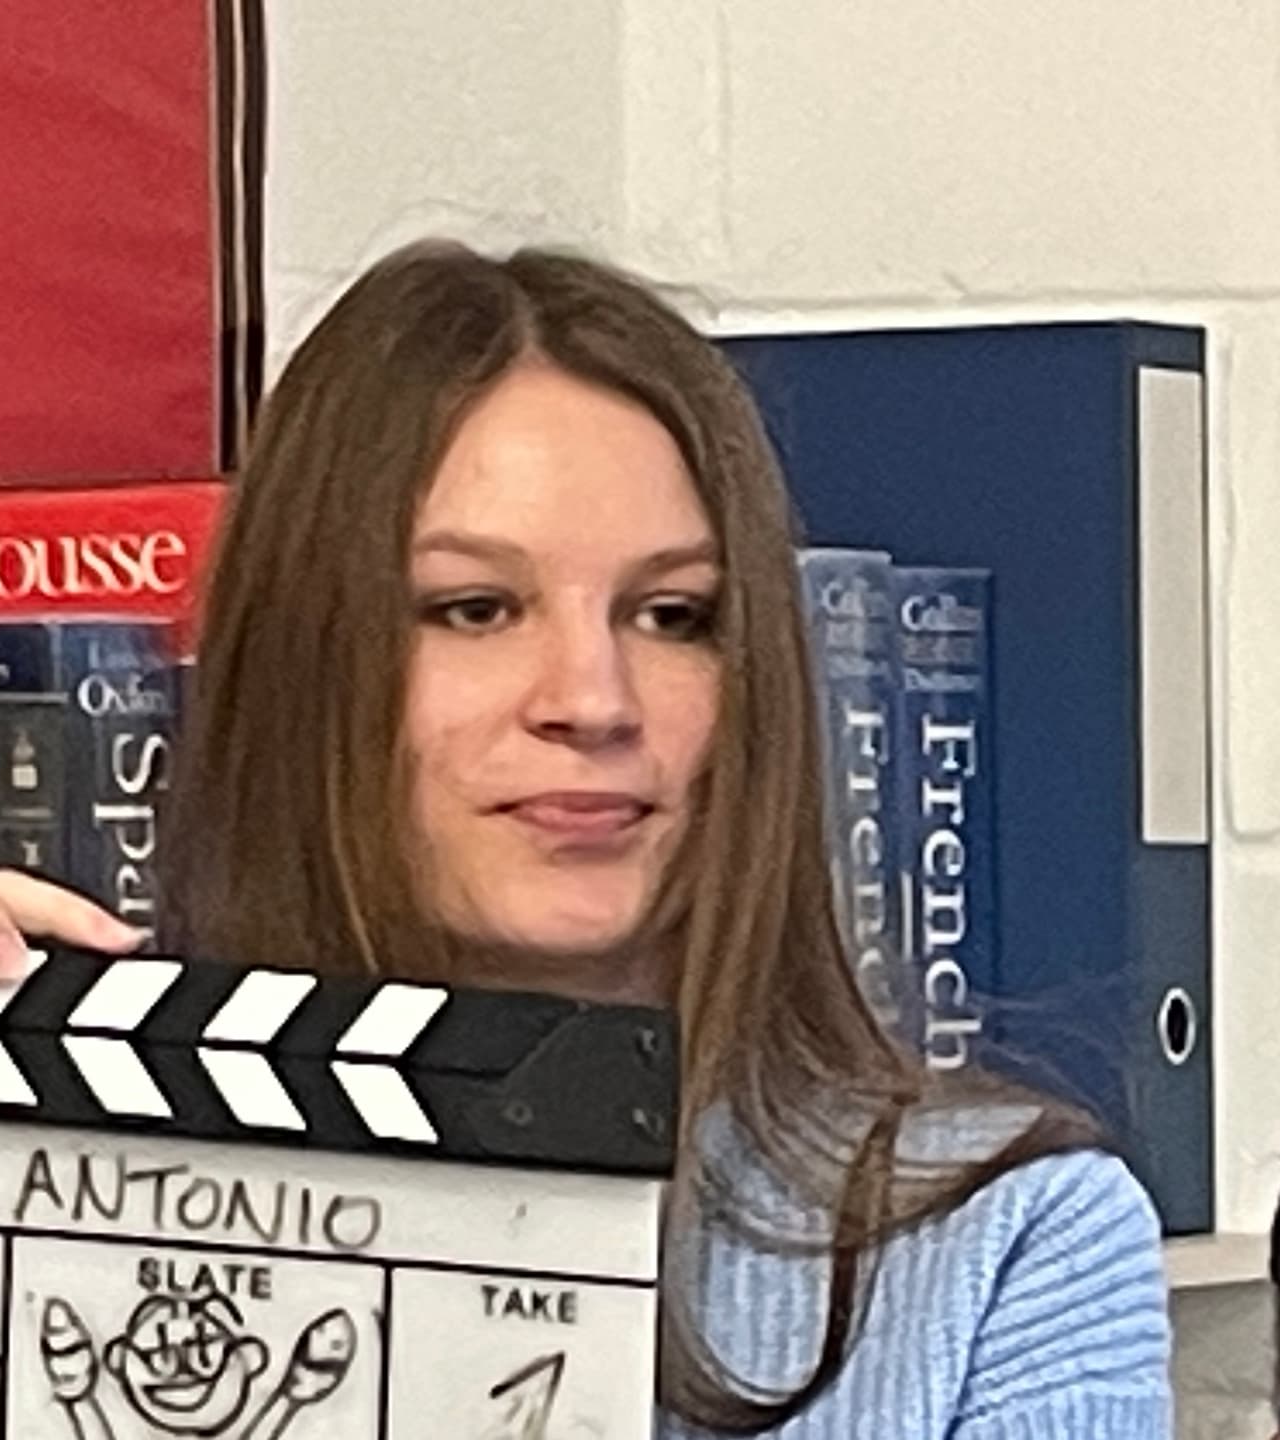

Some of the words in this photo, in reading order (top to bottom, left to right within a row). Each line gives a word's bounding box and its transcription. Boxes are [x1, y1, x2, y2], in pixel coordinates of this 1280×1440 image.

[922, 713, 983, 1070] French
[13, 1147, 383, 1251] ANTONIO
[136, 1257, 274, 1302] SLATE
[478, 1284, 579, 1326] TAKE
